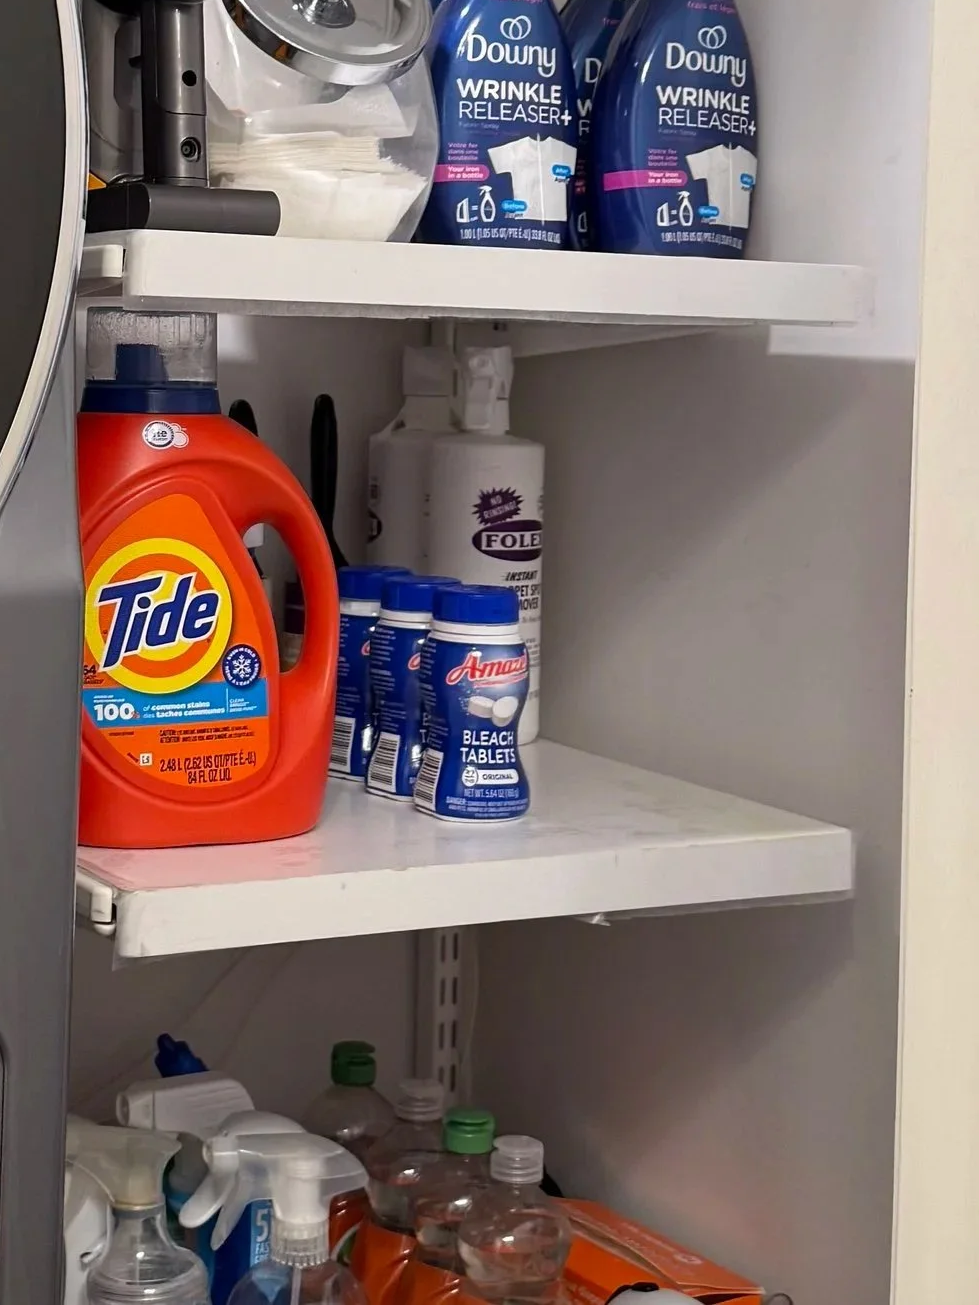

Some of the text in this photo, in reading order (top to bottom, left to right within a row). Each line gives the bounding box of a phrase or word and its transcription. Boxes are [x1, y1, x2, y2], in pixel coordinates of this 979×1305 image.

[466, 33, 557, 78] Downy
[665, 42, 747, 88] Downy
[456, 77, 562, 105] WRINKLE
[655, 84, 750, 115] WRINKLE
[458, 101, 573, 126] RELEASER+
[658, 107, 757, 136] RELEASER+
[490, 494, 502, 505] NO
[505, 570, 538, 582] INSTANT
[96, 572, 221, 671] Tide
[151, 703, 186, 711] common
[187, 700, 210, 709] stains
[156, 710, 183, 719] taches
[184, 707, 225, 717] communes
[463, 730, 514, 746] BLEACH
[203, 756, 213, 769] US
[460, 747, 516, 764] TABLETS
[188, 771, 198, 784] 84
[198, 770, 208, 783] FL
[208, 769, 218, 782] OZ
